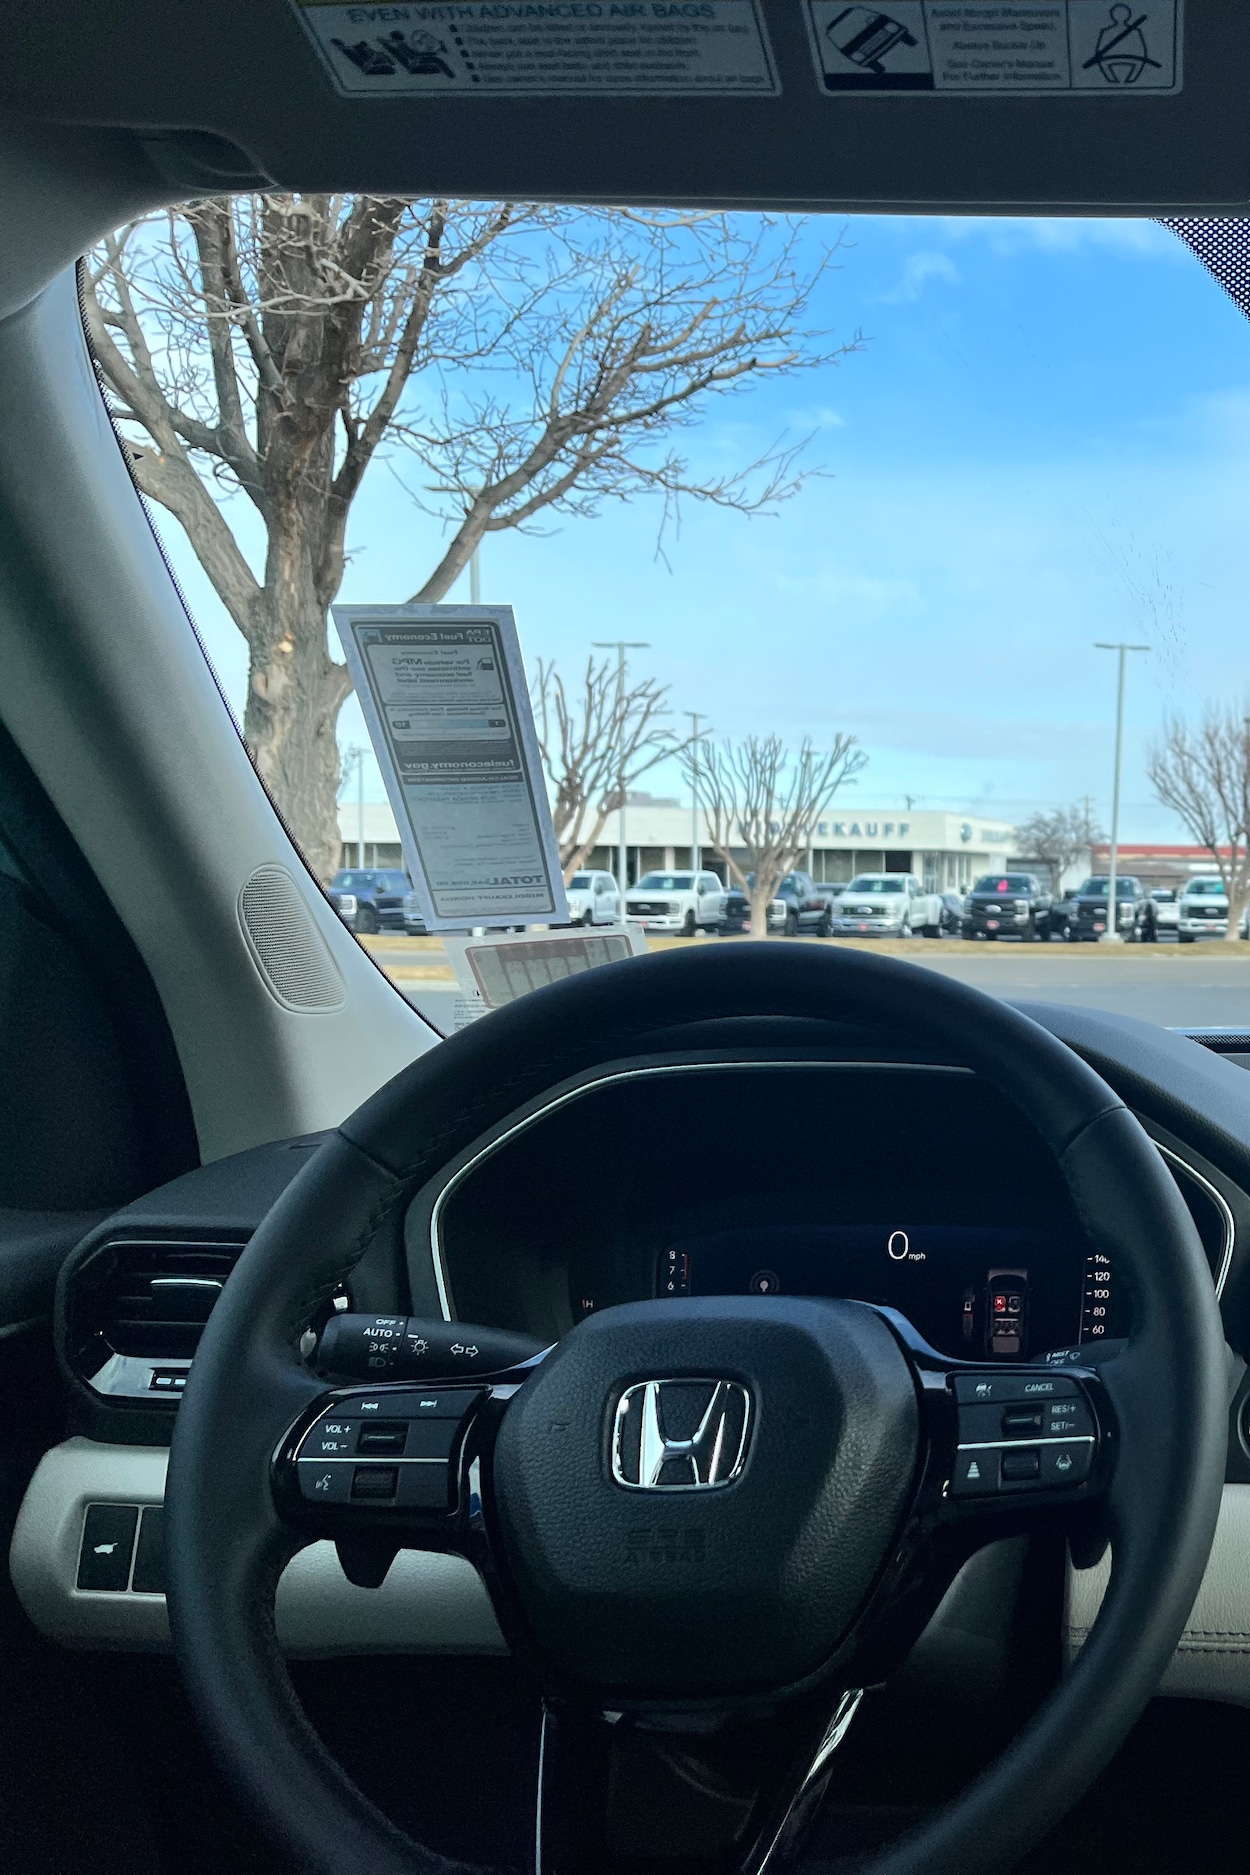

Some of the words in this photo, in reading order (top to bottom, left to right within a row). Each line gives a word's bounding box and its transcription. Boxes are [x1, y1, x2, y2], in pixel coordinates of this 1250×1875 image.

[348, 6, 411, 24] EVEN
[416, 5, 475, 20] WITH
[480, 3, 603, 19] ADVANCED
[610, 2, 648, 17] AIR
[651, 2, 716, 18] BAGS
[888, 1231, 909, 1260] 0
[909, 1251, 927, 1263] mph
[668, 1250, 676, 1260] 8
[668, 1265, 676, 1275] 7
[1094, 1271, 1111, 1282] 120
[666, 1280, 675, 1291] 6
[1093, 1289, 1110, 1299] 100
[1092, 1306, 1106, 1317] 80
[375, 1318, 397, 1326] OFF
[362, 1327, 393, 1339] AUTO
[1091, 1324, 1105, 1335] 60
[1024, 1382, 1055, 1393] CANCEL
[1051, 1404, 1076, 1414] RES/+
